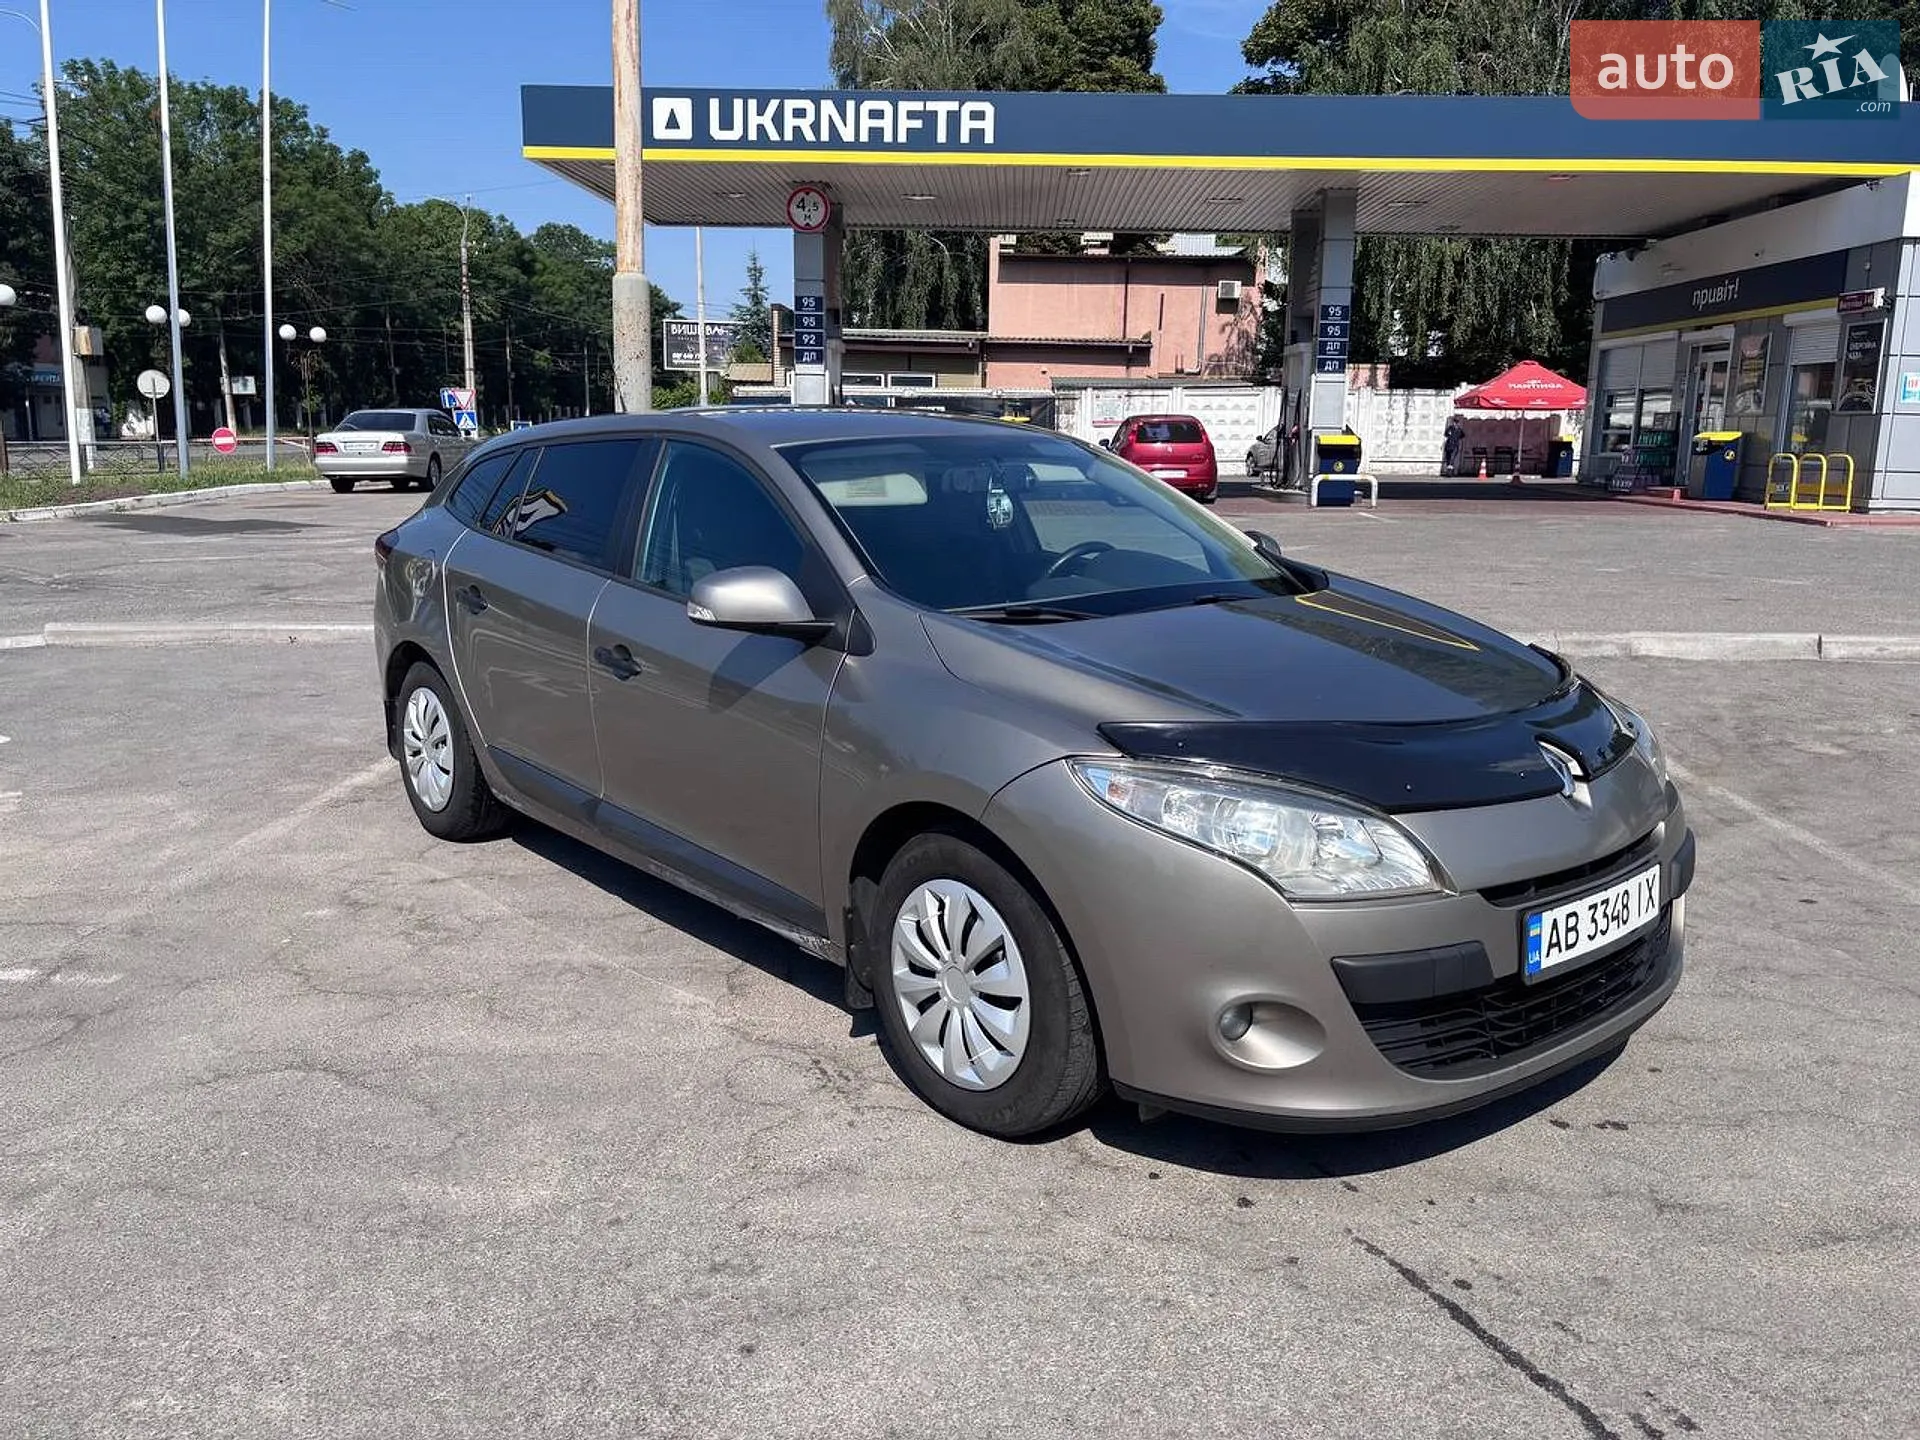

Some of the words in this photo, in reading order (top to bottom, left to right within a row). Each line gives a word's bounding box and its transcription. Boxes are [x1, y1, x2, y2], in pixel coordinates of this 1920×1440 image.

[709, 97, 996, 145] UKRNAFTA
[1691, 277, 1741, 311] привіт!
[802, 297, 816, 308] 95
[1328, 306, 1342, 317] 95
[802, 317, 816, 327] 95
[1327, 325, 1341, 336] 95
[802, 334, 816, 345] 92
[1545, 910, 1580, 959] AB
[1587, 889, 1630, 942] 3348
[1637, 873, 1656, 918] IX
[1528, 950, 1541, 965] UA
